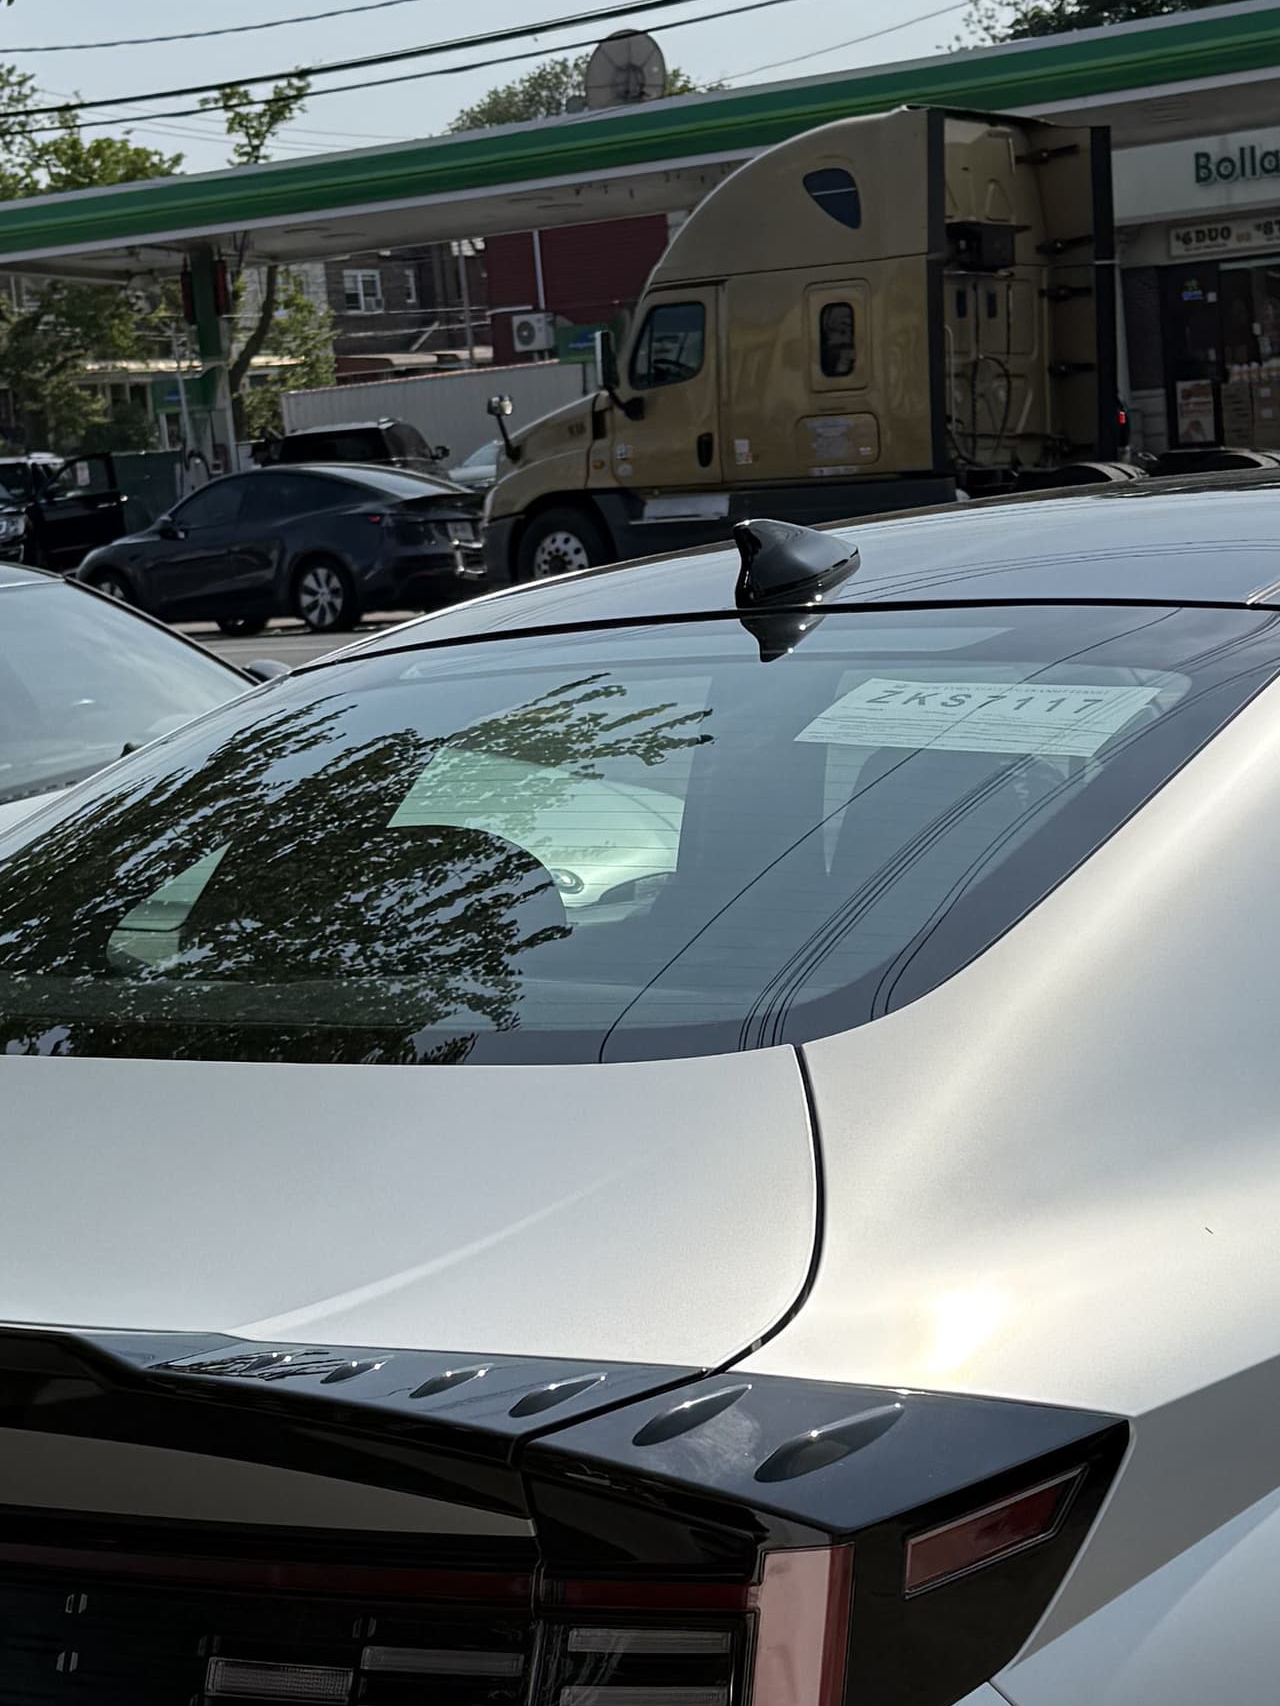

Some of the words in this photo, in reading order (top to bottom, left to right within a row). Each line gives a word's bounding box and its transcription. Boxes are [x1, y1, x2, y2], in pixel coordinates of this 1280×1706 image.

[1194, 144, 1280, 184] Bolla
[1194, 226, 1232, 243] DUO
[865, 689, 1103, 714] ZKS7117
